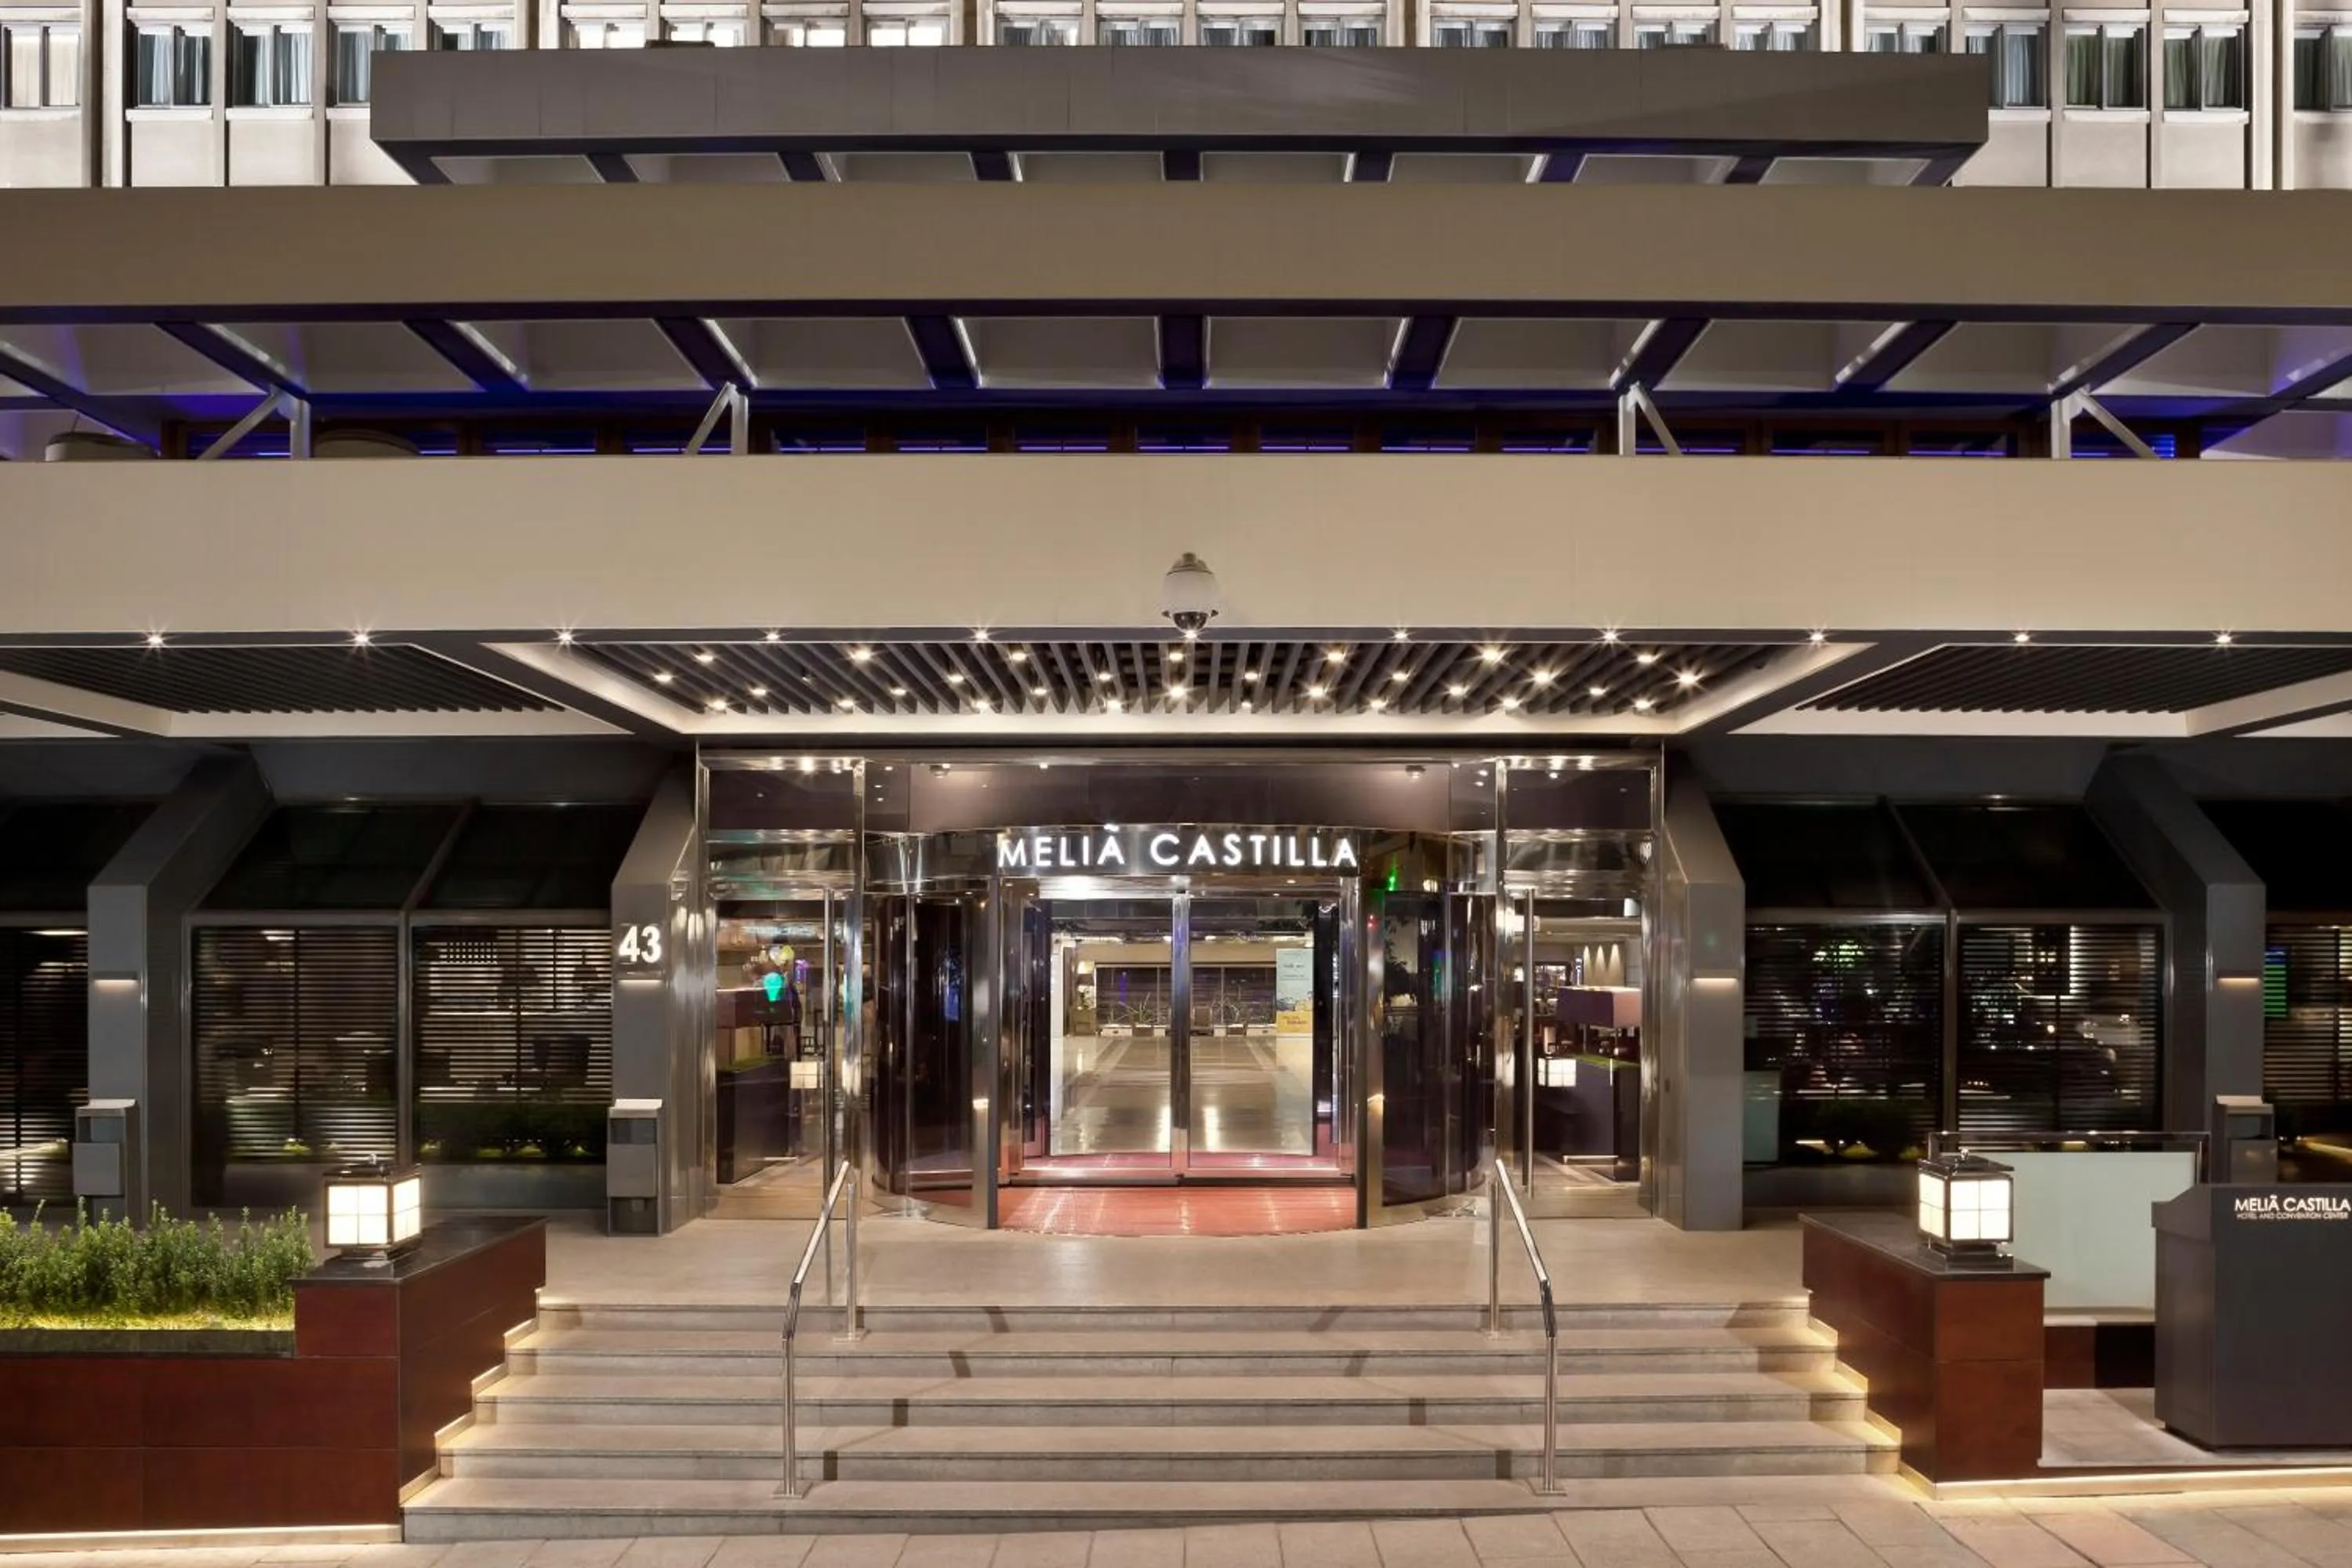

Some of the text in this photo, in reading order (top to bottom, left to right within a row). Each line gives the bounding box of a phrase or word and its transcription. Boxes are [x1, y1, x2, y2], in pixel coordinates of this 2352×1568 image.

[1150, 833, 1357, 867] CASTILLA
[619, 925, 662, 964] 43
[2283, 1197, 2351, 1211] CASTILLA
